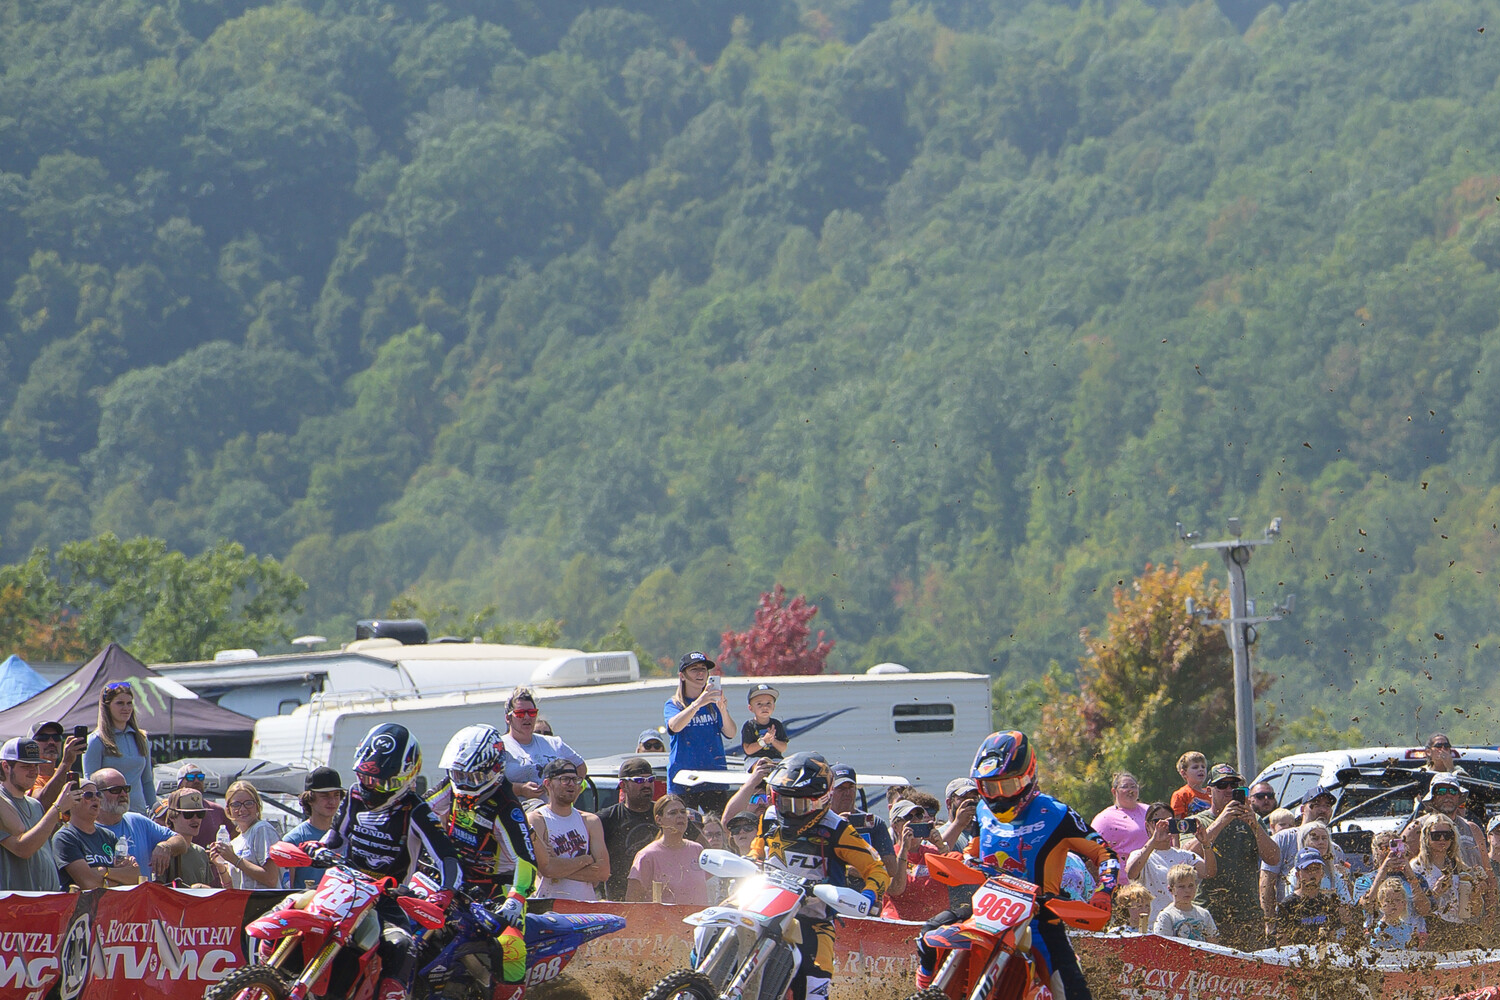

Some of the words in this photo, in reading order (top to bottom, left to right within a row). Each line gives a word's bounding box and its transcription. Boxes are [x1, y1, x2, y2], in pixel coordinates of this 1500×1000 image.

[692, 712, 717, 725] YAMA
[353, 824, 393, 841] HONDA
[789, 855, 824, 869] FLY
[936, 871, 949, 879] KTM
[311, 879, 371, 922] 282
[974, 893, 1026, 926] 969
[1075, 917, 1090, 925] KTM
[105, 919, 150, 943] ROCKY
[1117, 962, 1180, 990] ROCKY
